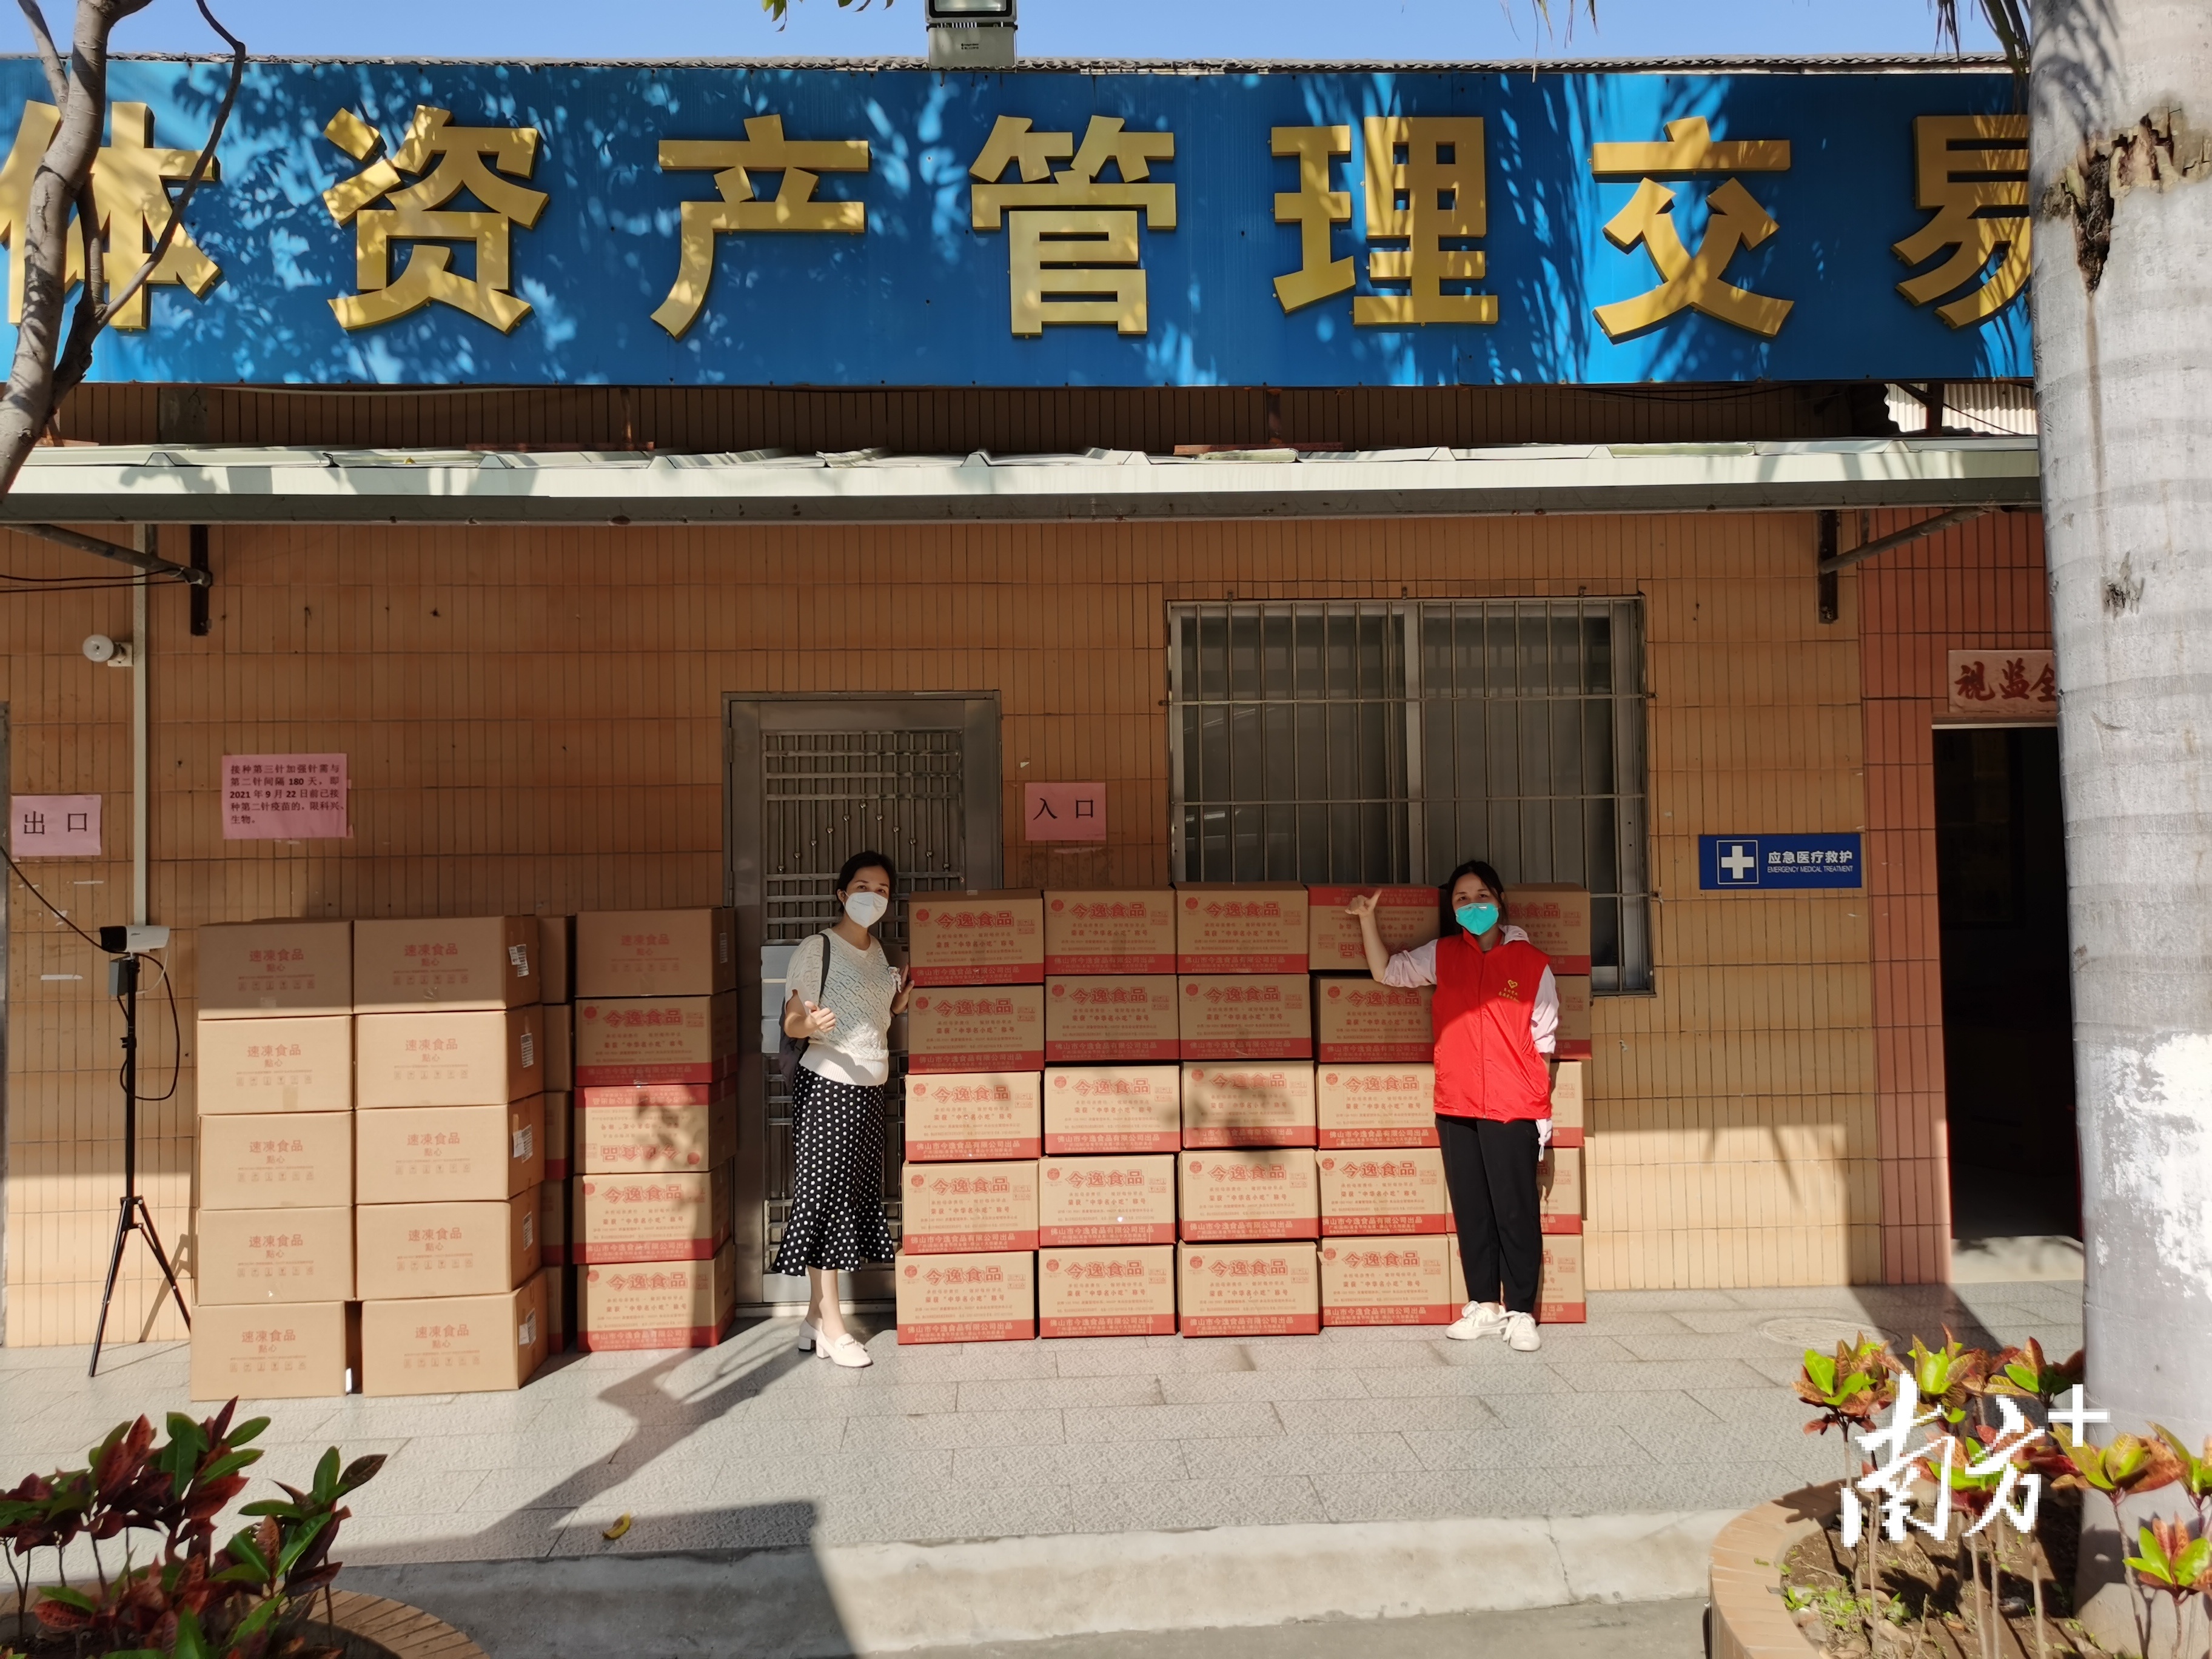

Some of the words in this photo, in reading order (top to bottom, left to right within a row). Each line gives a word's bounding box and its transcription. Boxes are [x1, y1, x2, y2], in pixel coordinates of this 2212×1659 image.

[1033, 797, 1093, 820] 入口
[24, 811, 87, 834] 出口
[1768, 851, 1852, 864] 应急医疗救护
